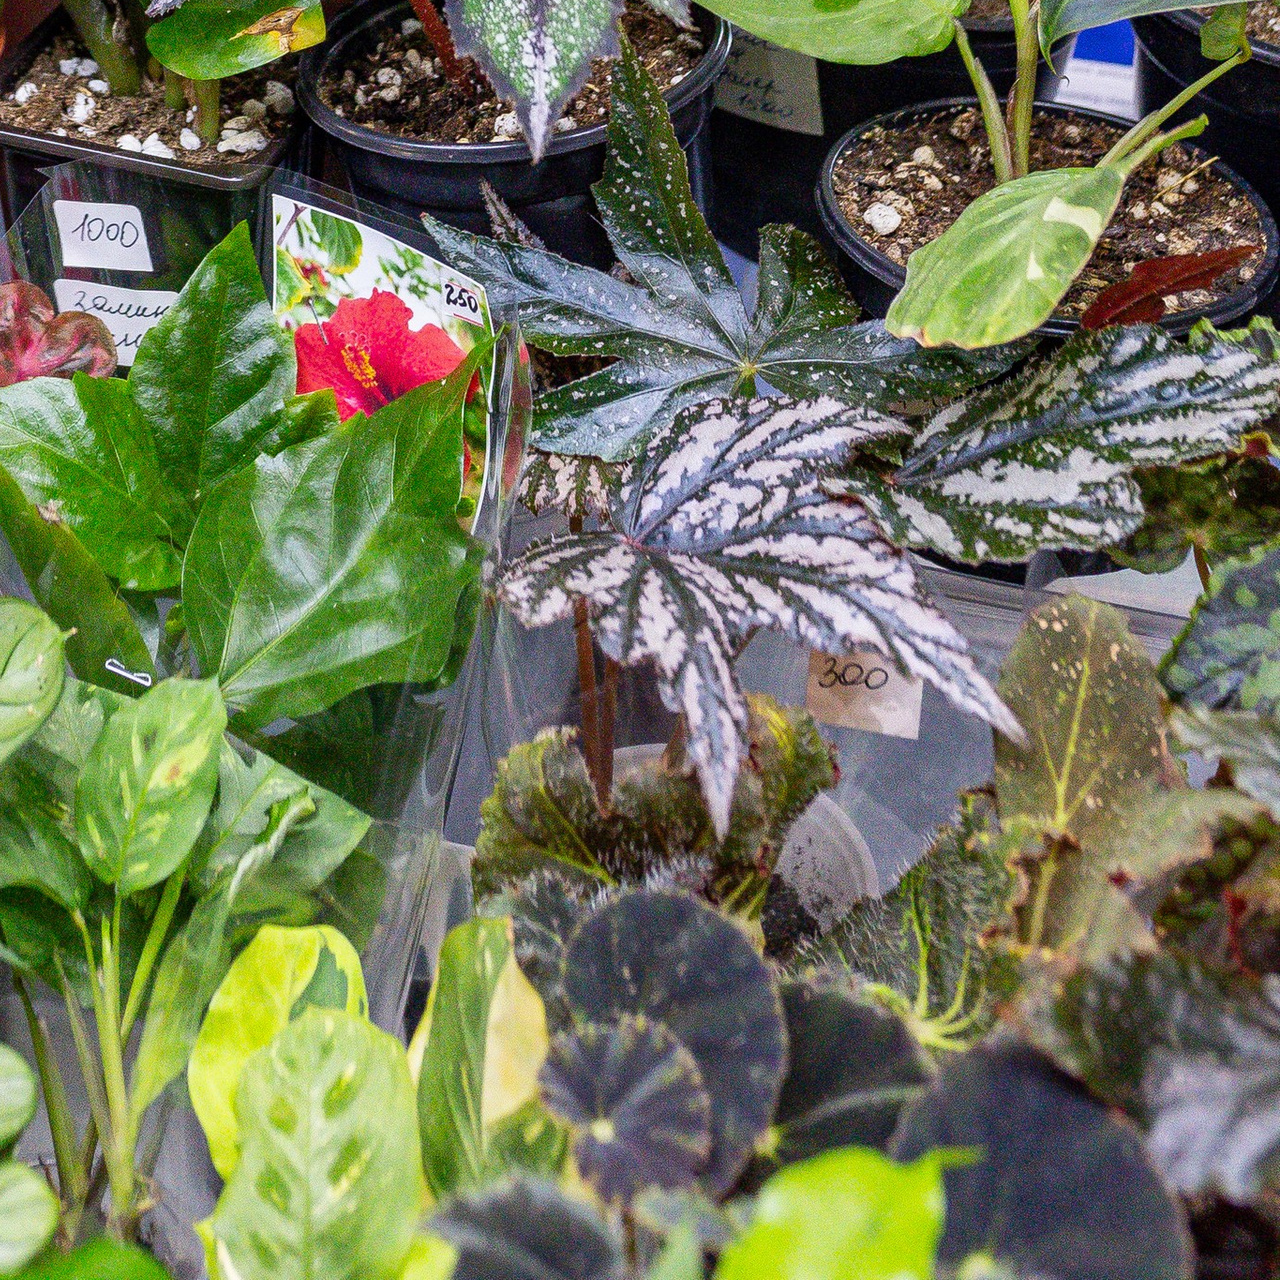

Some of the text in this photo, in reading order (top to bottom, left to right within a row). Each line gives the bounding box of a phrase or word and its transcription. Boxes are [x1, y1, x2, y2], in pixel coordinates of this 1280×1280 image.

[71, 213, 140, 248] 1000
[444, 283, 479, 314] 250
[818, 656, 889, 691] 300
